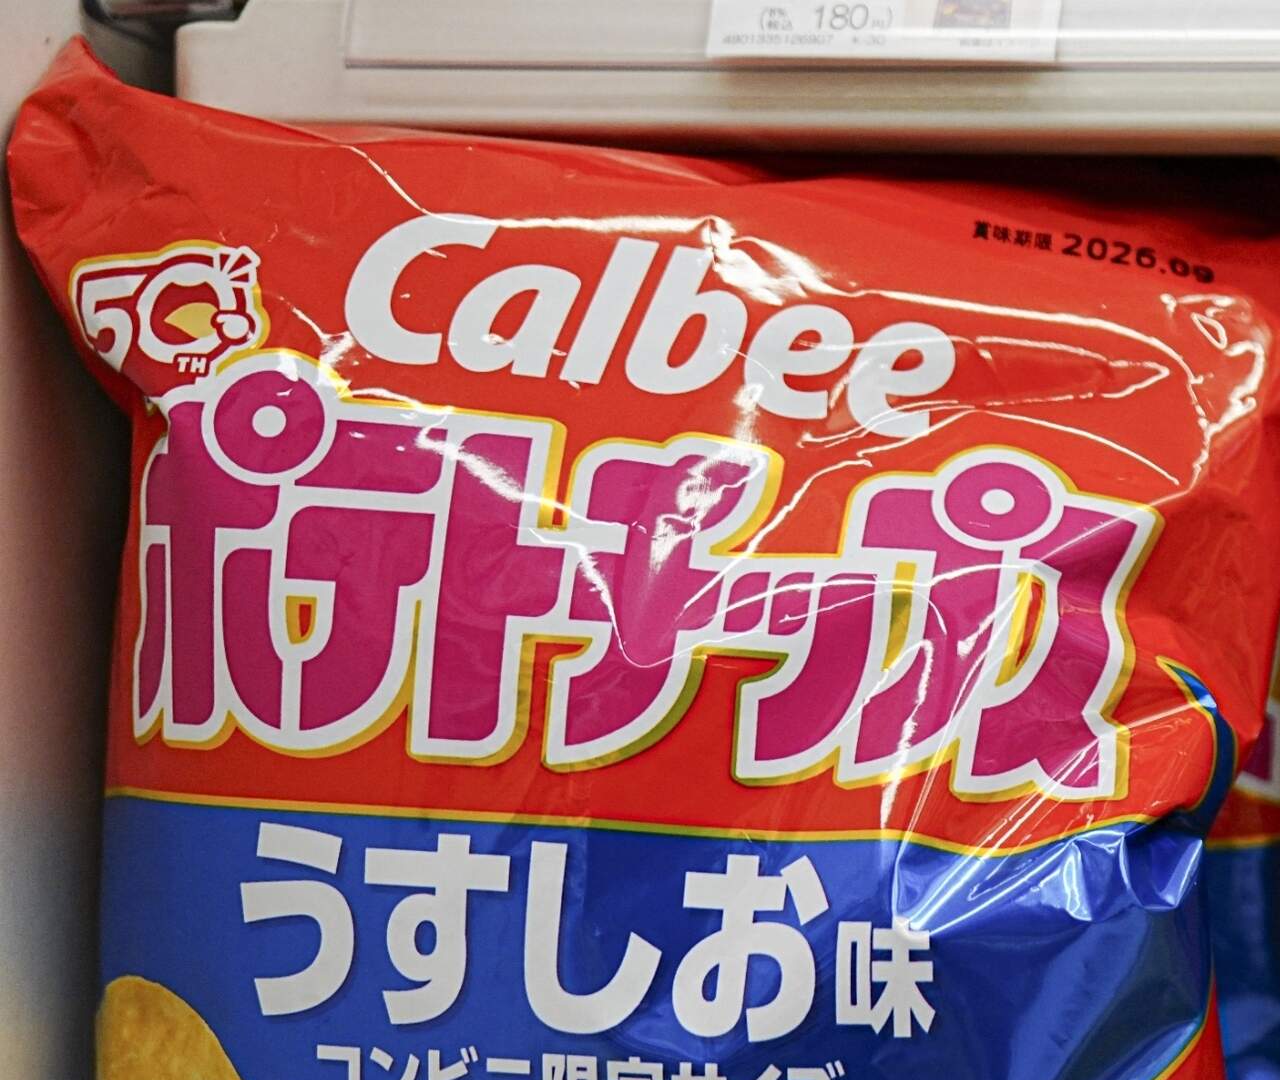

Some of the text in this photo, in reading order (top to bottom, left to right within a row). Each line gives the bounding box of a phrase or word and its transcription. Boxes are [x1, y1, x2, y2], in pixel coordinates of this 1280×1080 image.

[345, 213, 958, 440] Calbee
[972, 220, 1216, 285] 賞味期限 2026.09
[176, 356, 208, 374] TH
[132, 350, 1163, 802] ポテトチップス
[239, 821, 938, 1042] うすしお味
